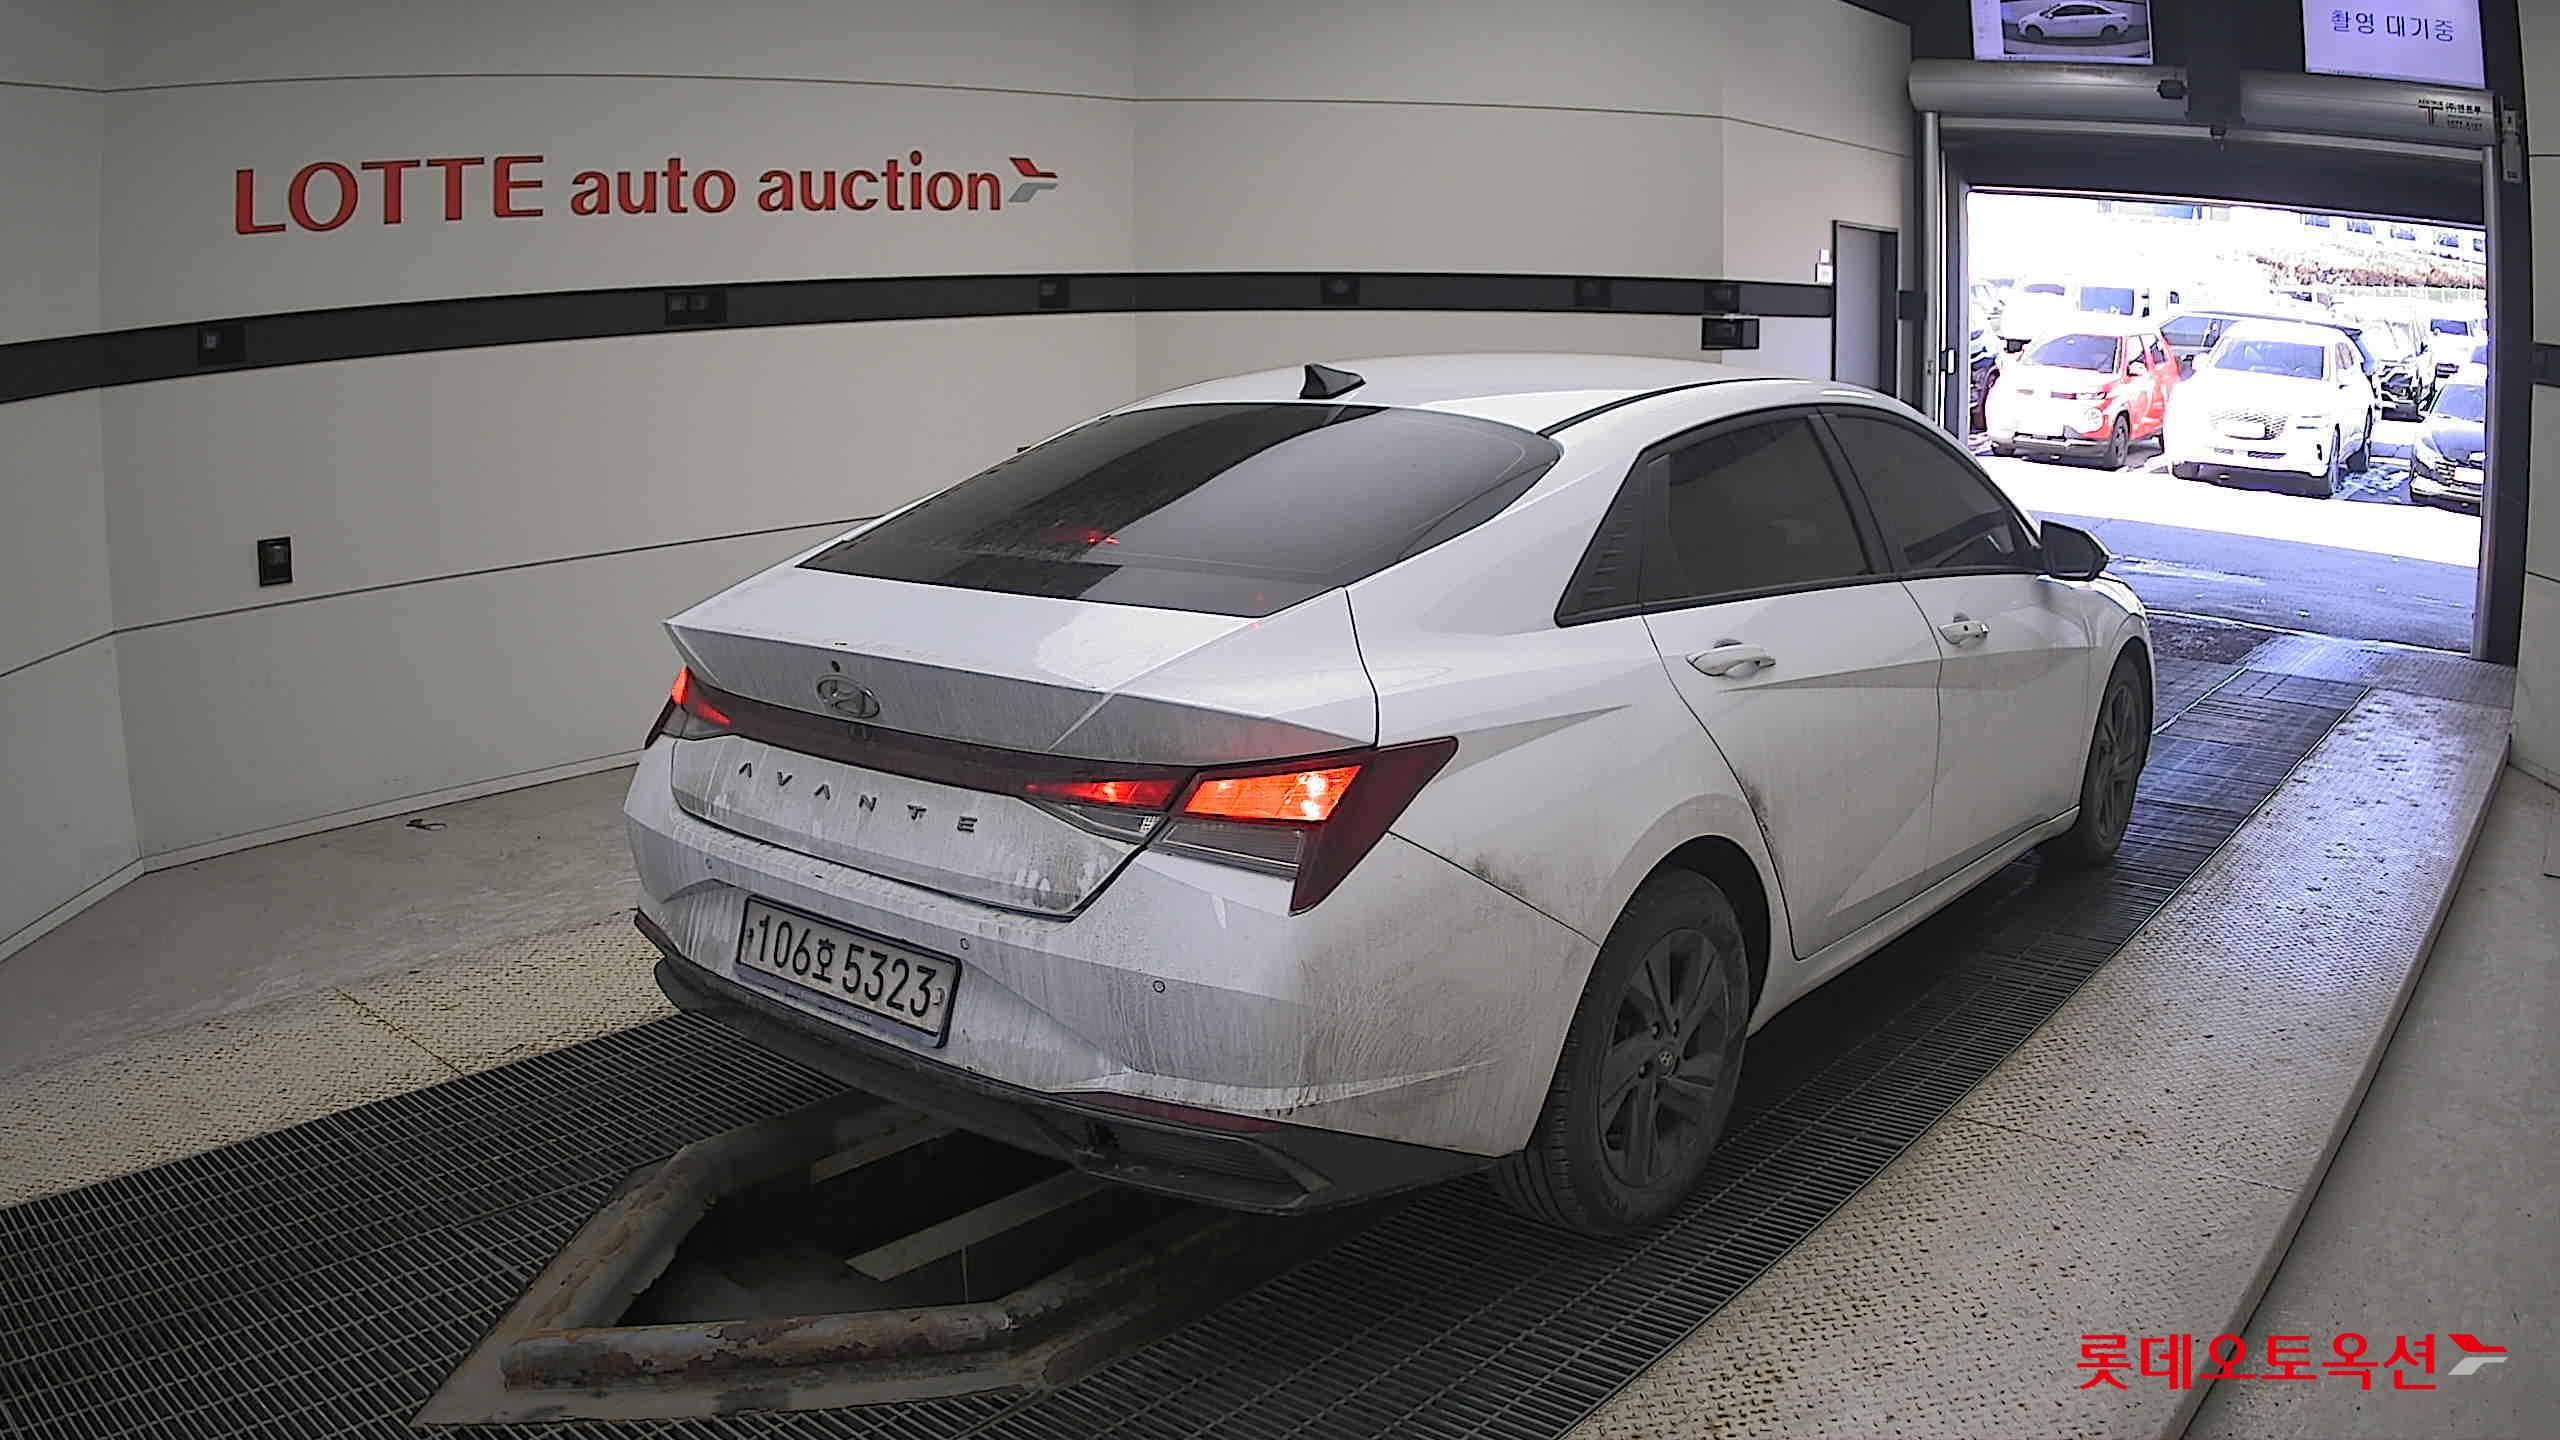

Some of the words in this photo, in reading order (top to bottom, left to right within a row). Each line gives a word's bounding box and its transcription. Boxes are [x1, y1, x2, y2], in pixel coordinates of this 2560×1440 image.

[2331, 9, 2375, 35] 촬영
[2386, 15, 2455, 42] 대기중
[236, 155, 544, 235] LOTTE
[570, 157, 736, 215] auto
[758, 150, 1001, 212] auction
[738, 762, 978, 833] AVANTE
